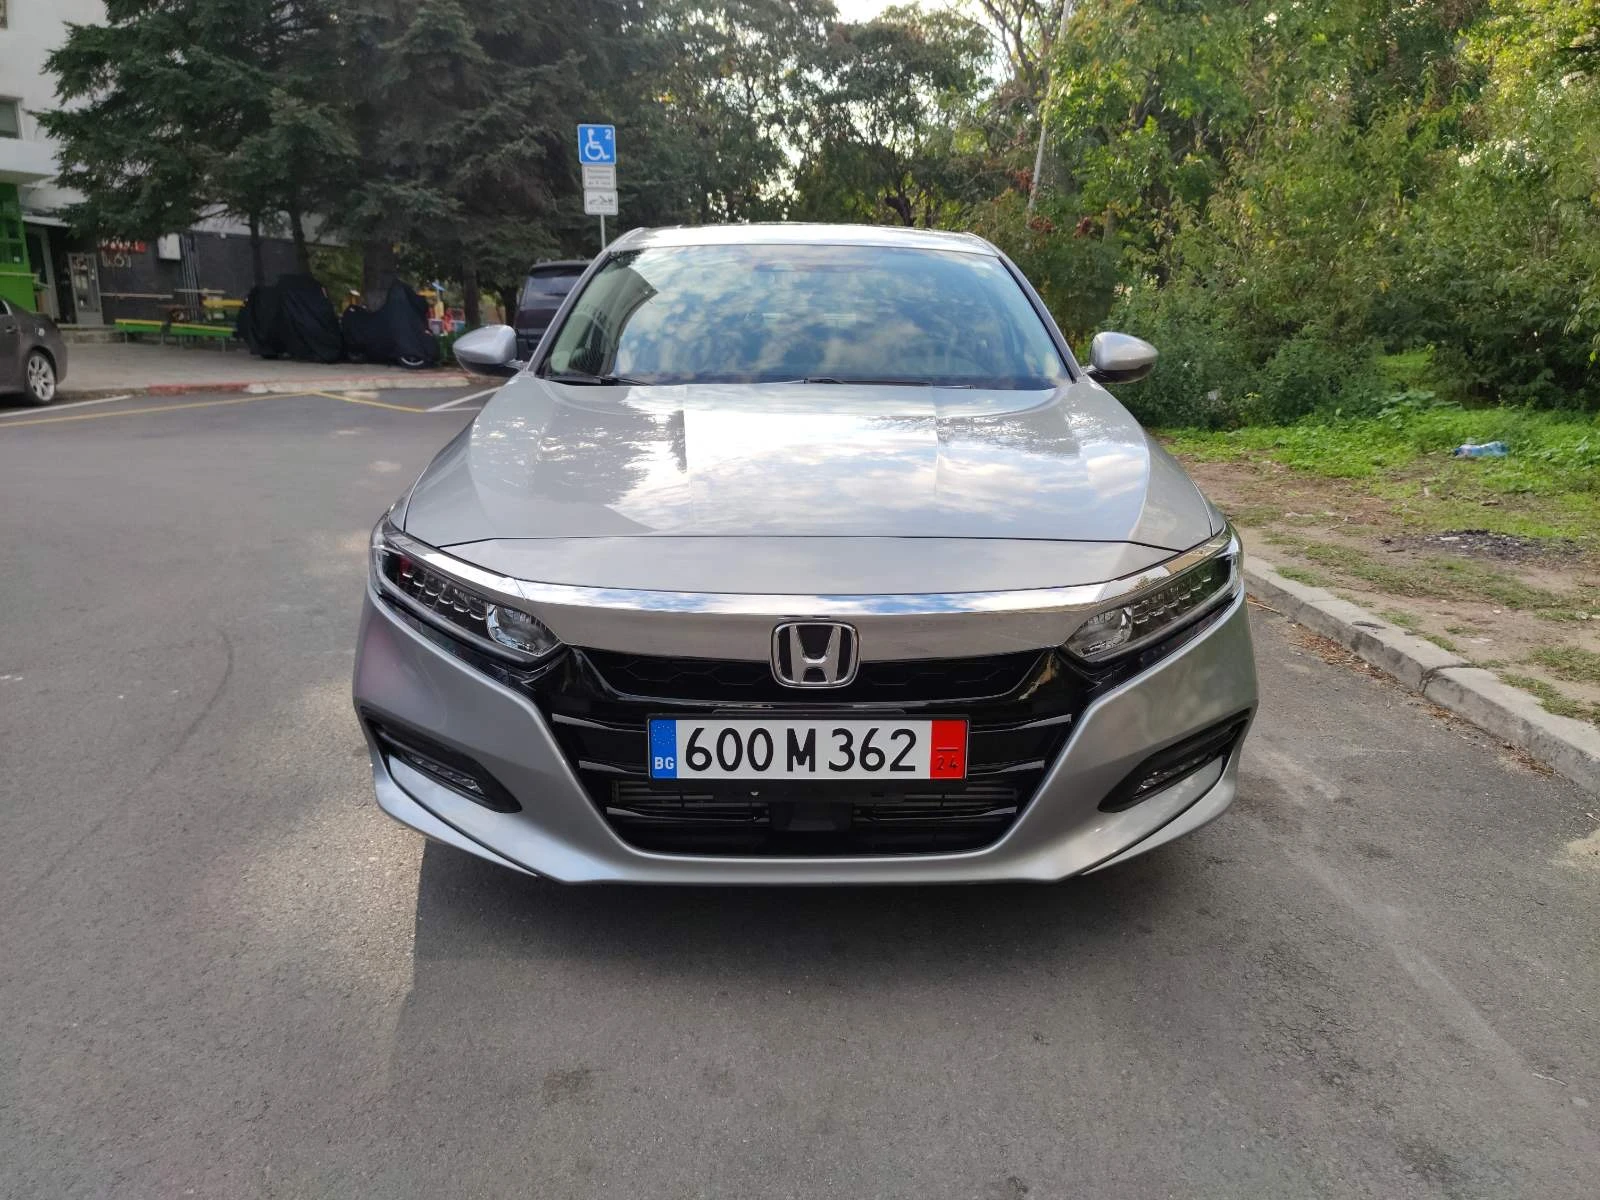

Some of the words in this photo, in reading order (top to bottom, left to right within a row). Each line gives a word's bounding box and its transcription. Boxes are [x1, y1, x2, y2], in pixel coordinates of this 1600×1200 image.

[604, 129, 612, 140] 2
[685, 727, 774, 772] 600
[786, 728, 816, 772] M
[828, 727, 917, 772] 362
[654, 756, 674, 770] BG
[935, 755, 959, 771] 24
